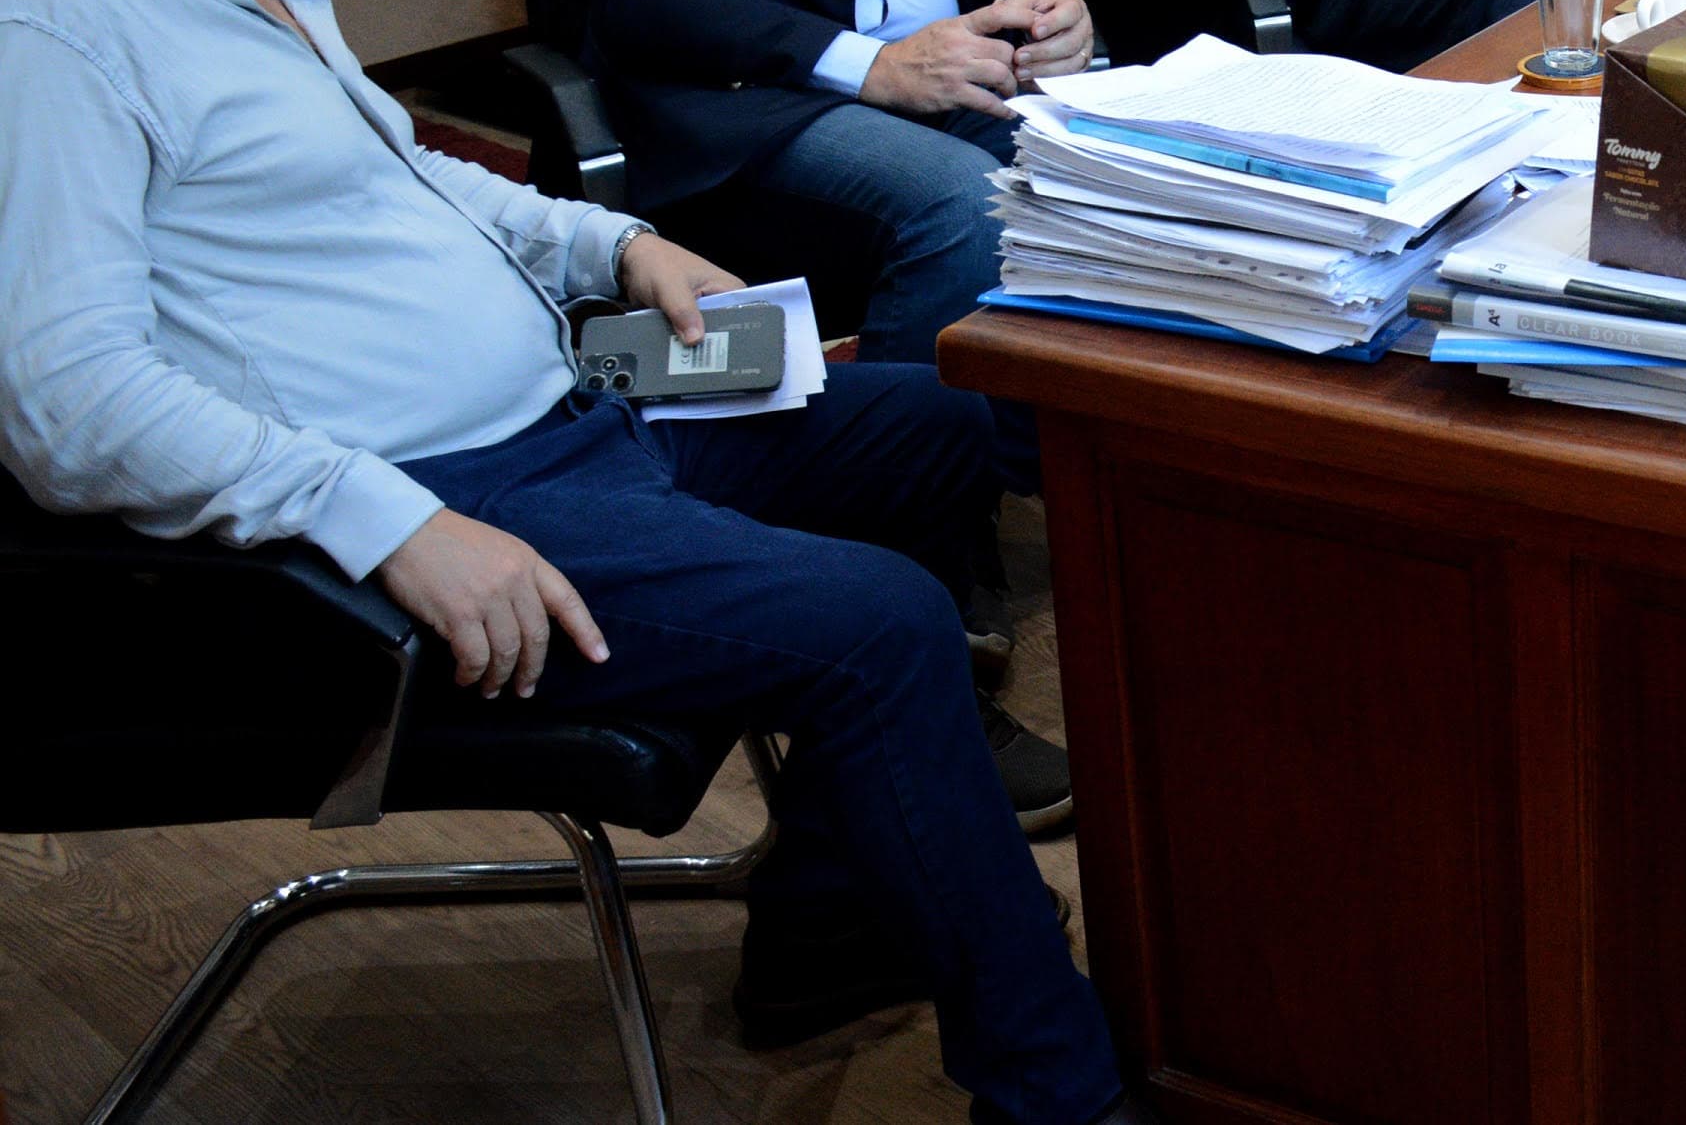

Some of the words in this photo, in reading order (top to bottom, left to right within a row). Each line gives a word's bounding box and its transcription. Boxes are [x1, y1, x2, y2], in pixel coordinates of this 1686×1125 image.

[1604, 138, 1662, 170] Tommy
[1519, 316, 1579, 337] CLEAR
[1589, 326, 1641, 346] BOOK
